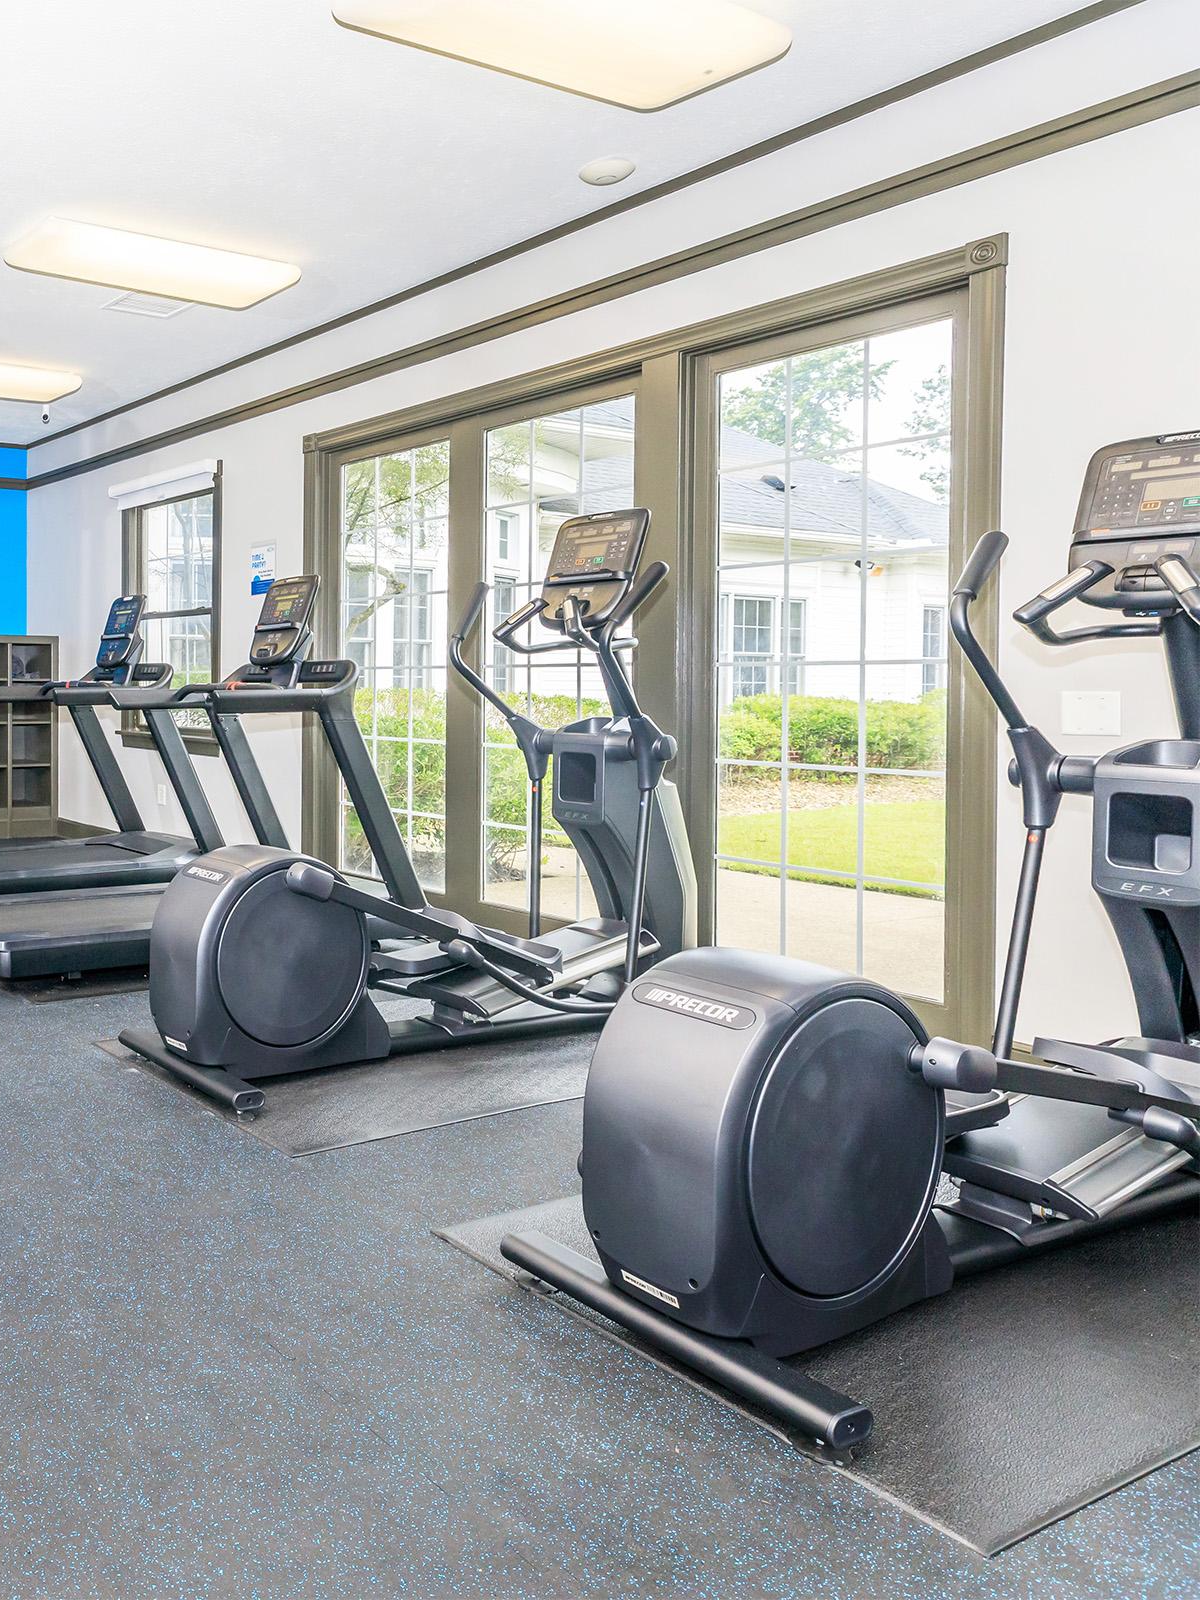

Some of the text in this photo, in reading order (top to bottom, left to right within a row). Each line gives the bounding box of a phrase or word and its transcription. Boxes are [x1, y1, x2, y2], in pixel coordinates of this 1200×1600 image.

[191, 867, 224, 882] PRECOR
[1120, 882, 1174, 896] EFX
[655, 990, 740, 1022] PRECOR
